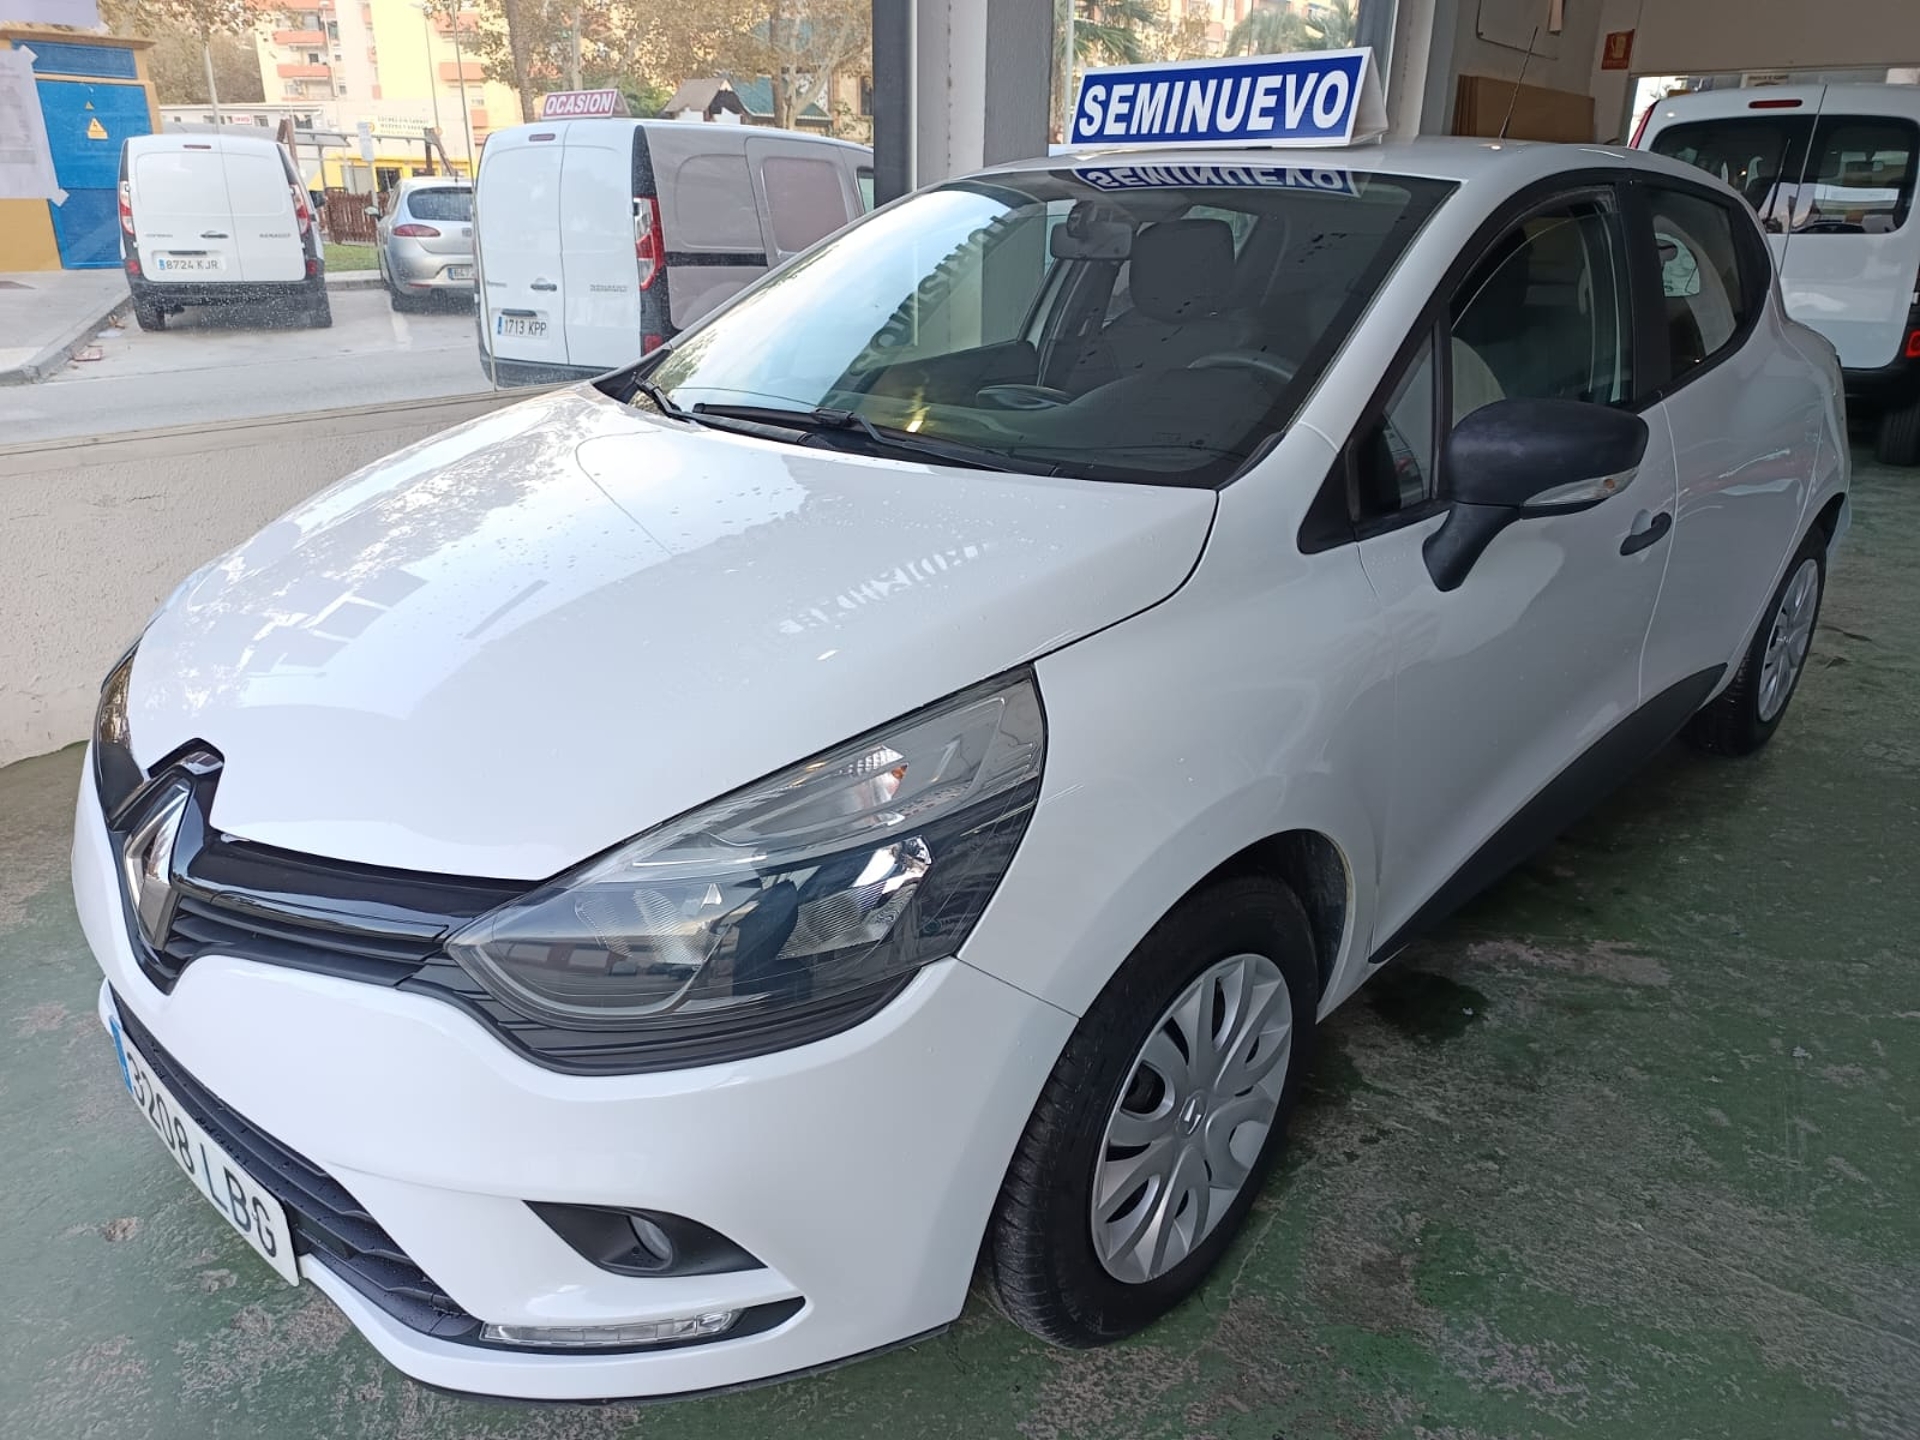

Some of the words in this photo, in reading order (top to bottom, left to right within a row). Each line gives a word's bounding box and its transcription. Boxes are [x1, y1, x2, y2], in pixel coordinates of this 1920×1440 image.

[545, 93, 613, 115] OCASION
[1079, 70, 1350, 137] SEMINUEVO
[166, 260, 194, 270] 8724
[197, 260, 219, 270] KJR
[505, 318, 525, 335] 1713
[528, 320, 547, 337] KPP
[126, 1051, 195, 1176] 3208
[199, 1142, 277, 1258] LBG
